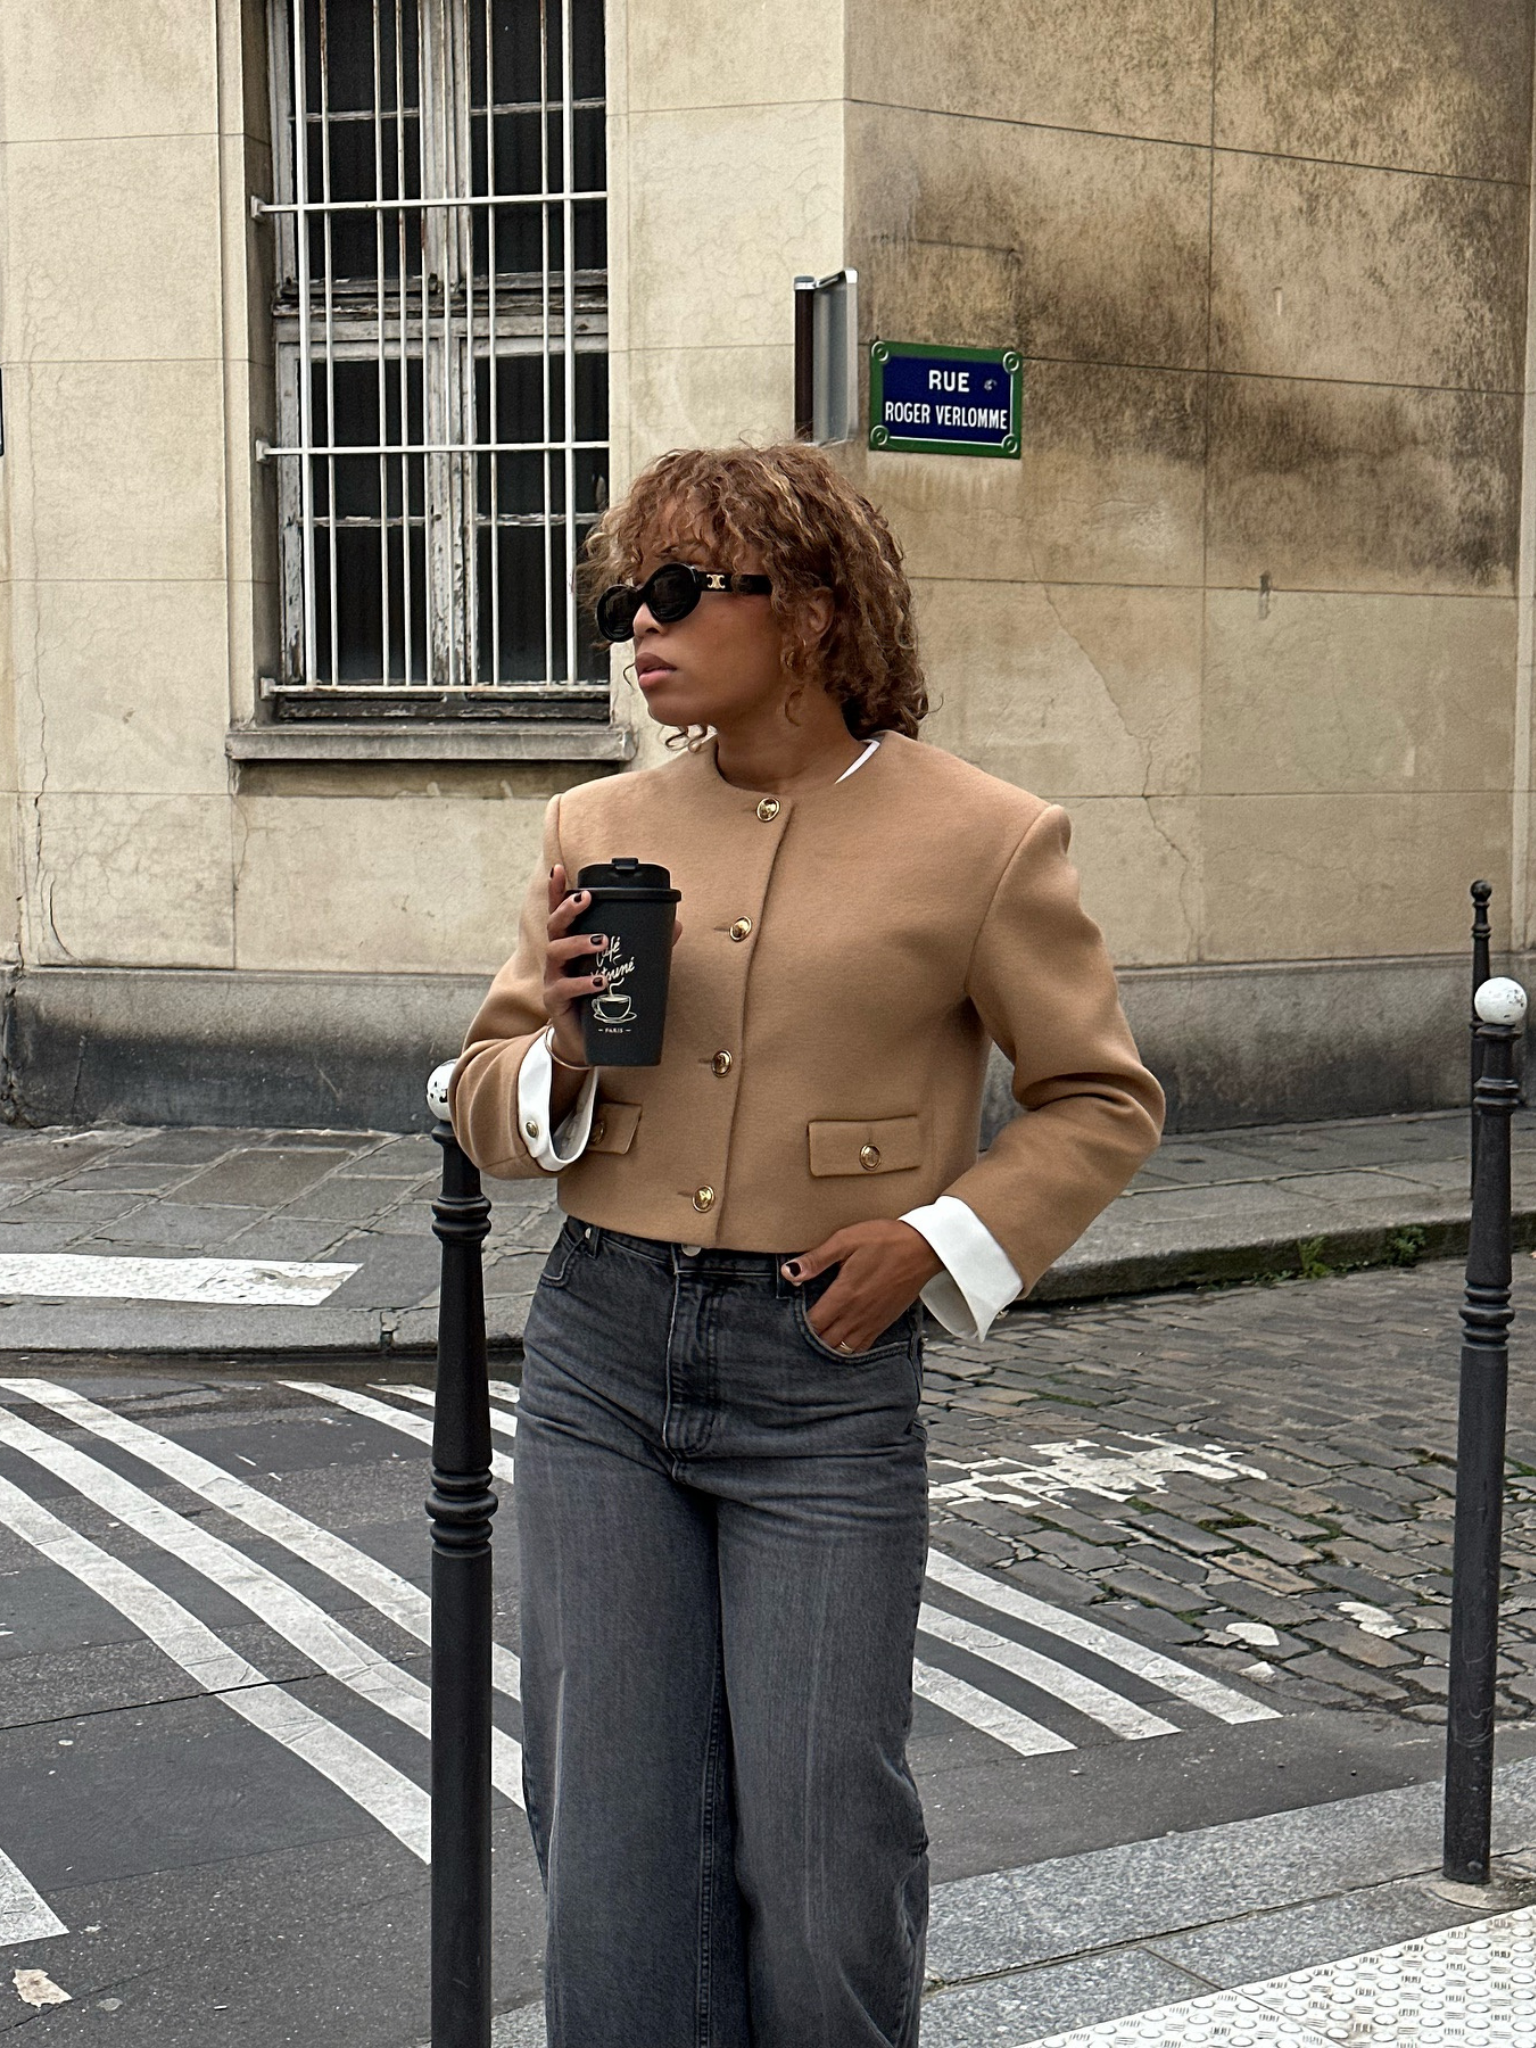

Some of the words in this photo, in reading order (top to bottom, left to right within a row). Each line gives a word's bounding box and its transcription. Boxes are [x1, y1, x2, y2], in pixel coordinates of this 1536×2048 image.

[928, 369, 970, 393] RUE
[885, 401, 931, 424] ROGER
[935, 404, 1008, 430] VERLOMME
